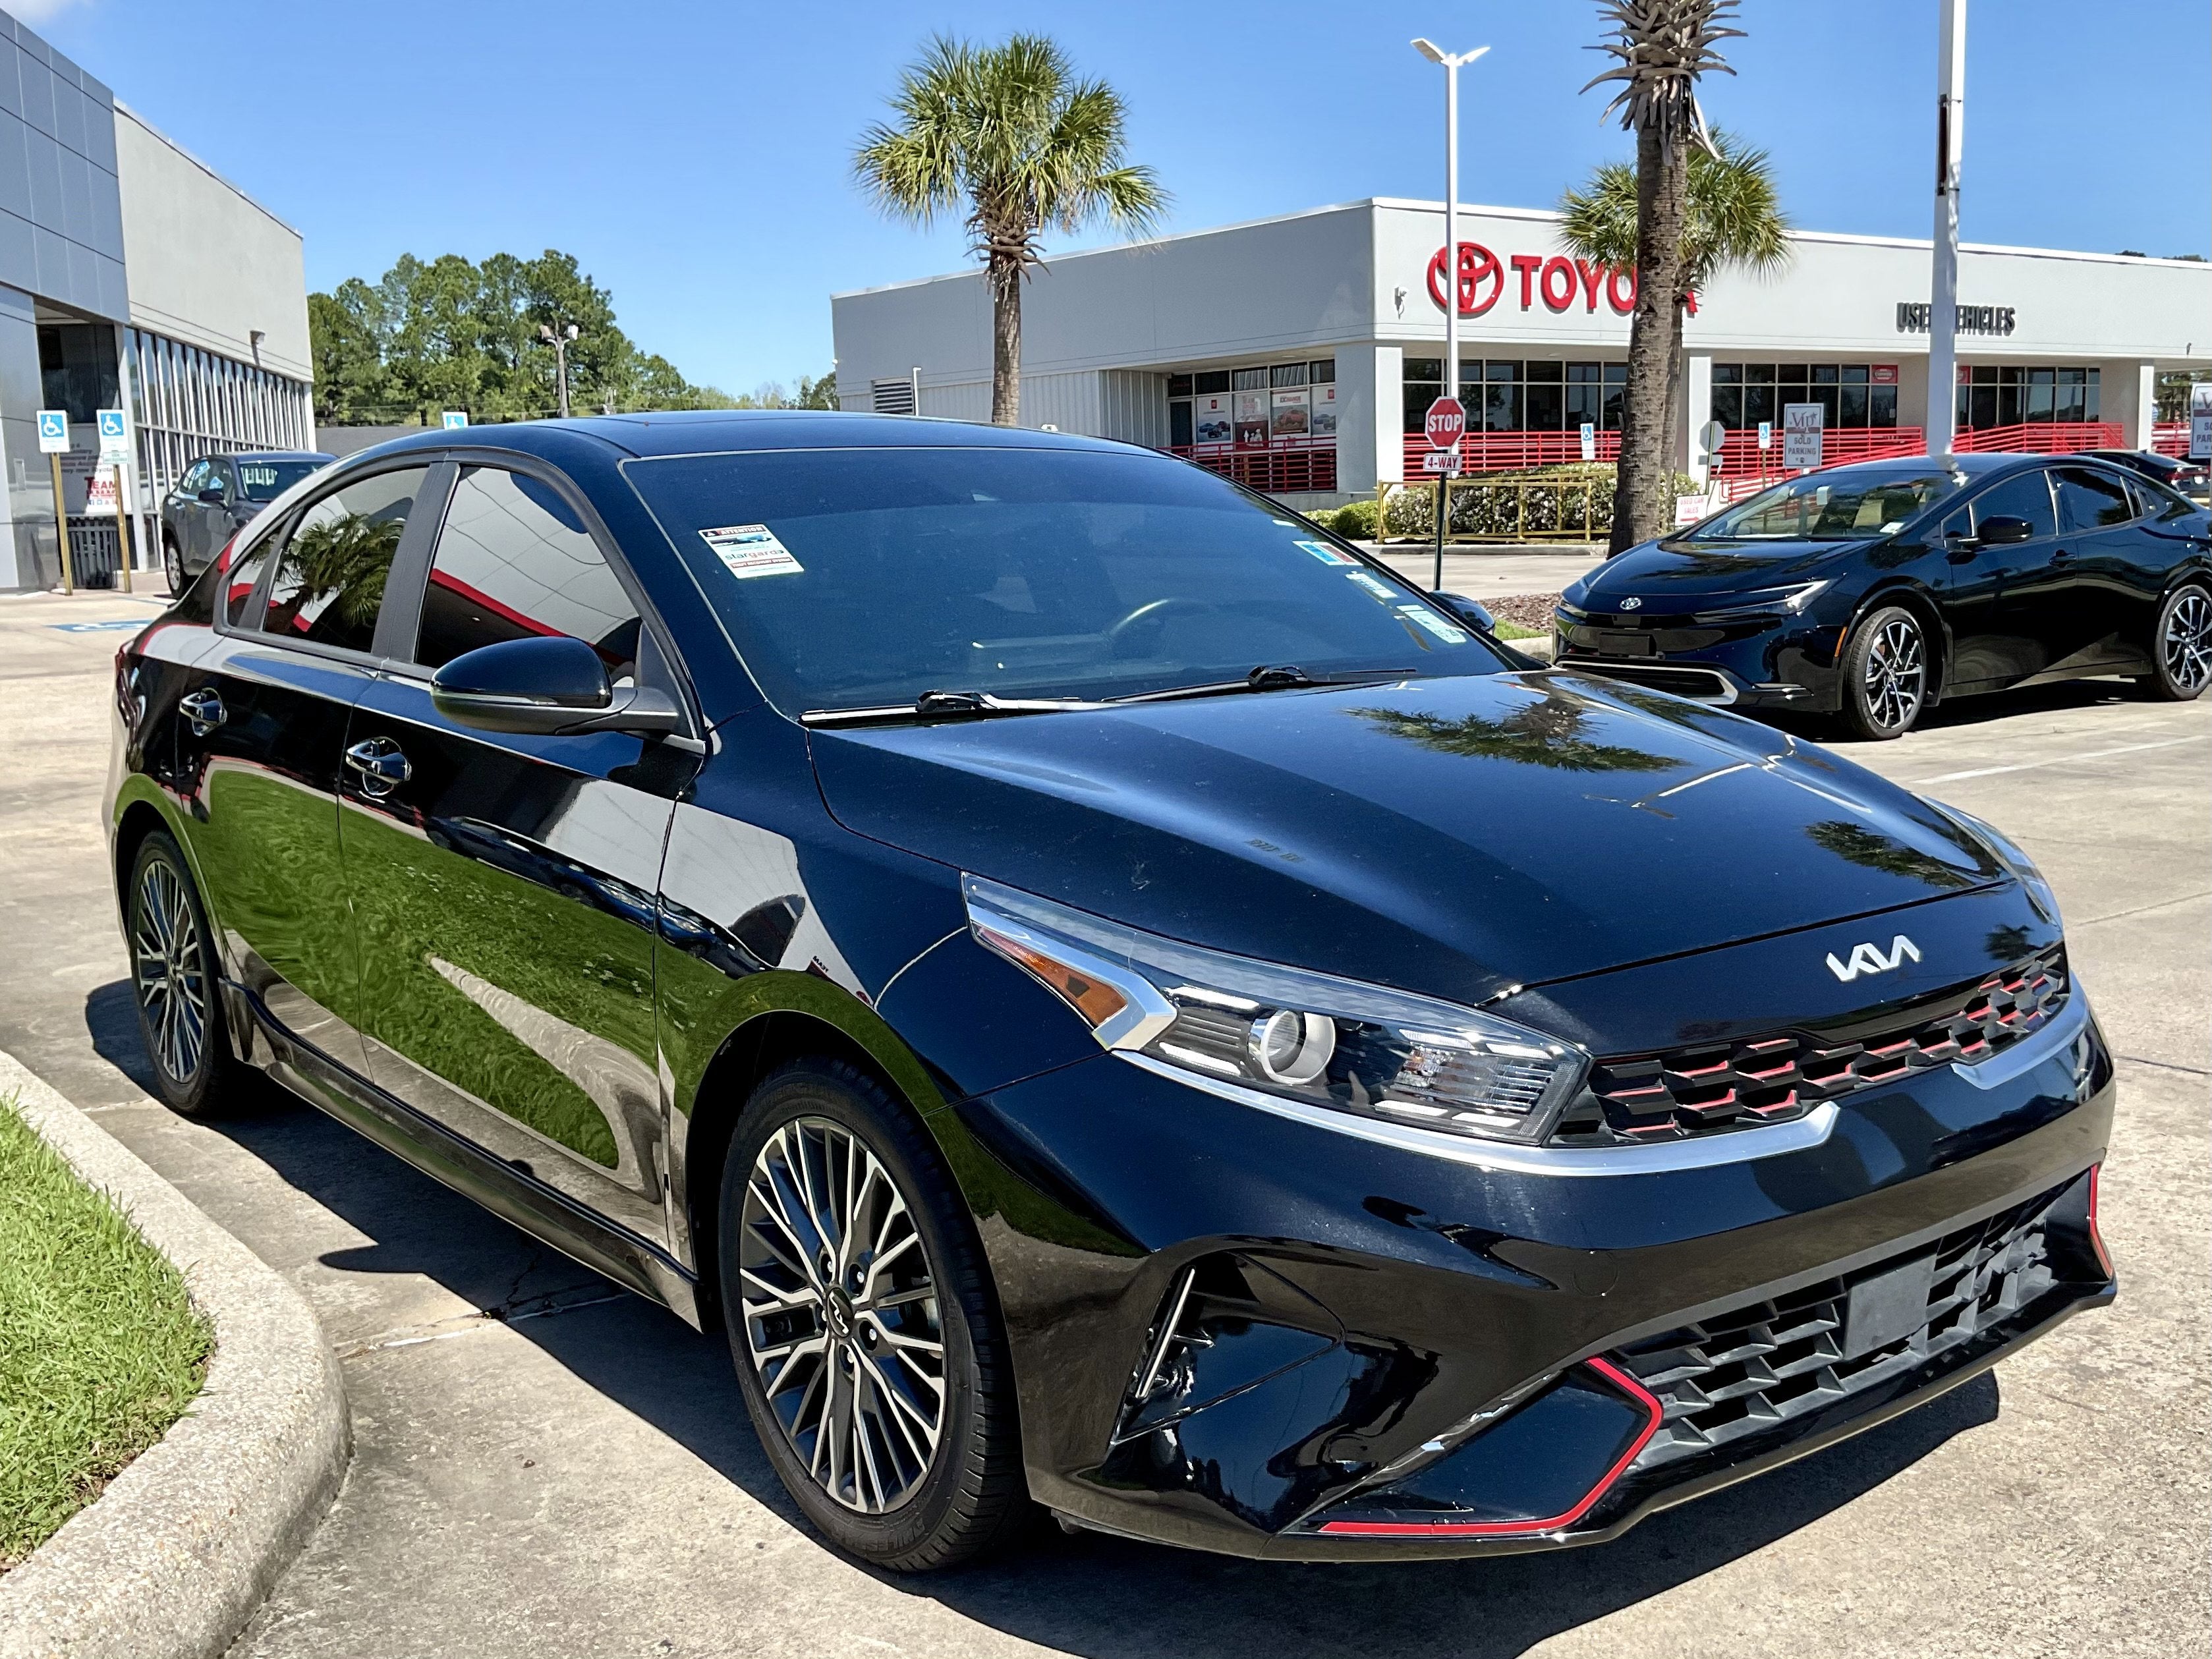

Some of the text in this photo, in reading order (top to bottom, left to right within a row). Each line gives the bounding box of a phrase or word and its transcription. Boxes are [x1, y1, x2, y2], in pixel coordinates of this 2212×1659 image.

[1511, 255, 1697, 312] TOYO
[1897, 302, 2015, 334] USE EHICLES
[1429, 414, 1461, 432] STOP
[1428, 457, 1458, 468] 4-WAY
[1826, 934, 1919, 982] KIA
